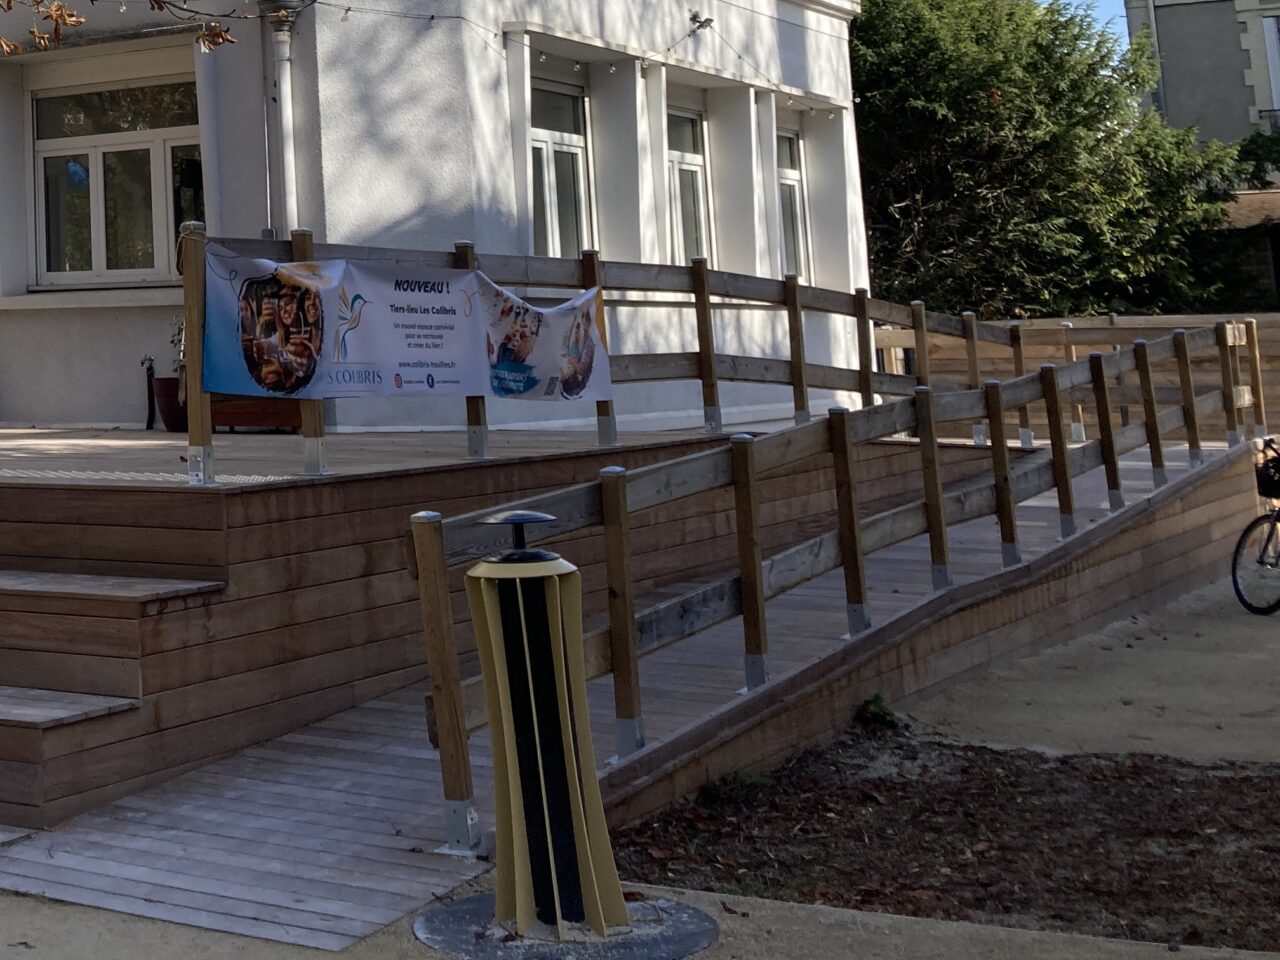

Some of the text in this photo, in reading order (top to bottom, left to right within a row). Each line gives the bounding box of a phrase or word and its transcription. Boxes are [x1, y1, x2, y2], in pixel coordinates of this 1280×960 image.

[394, 279, 450, 295] NOUVEAU !
[390, 304, 457, 316] Tiers-lieu Les Colibris
